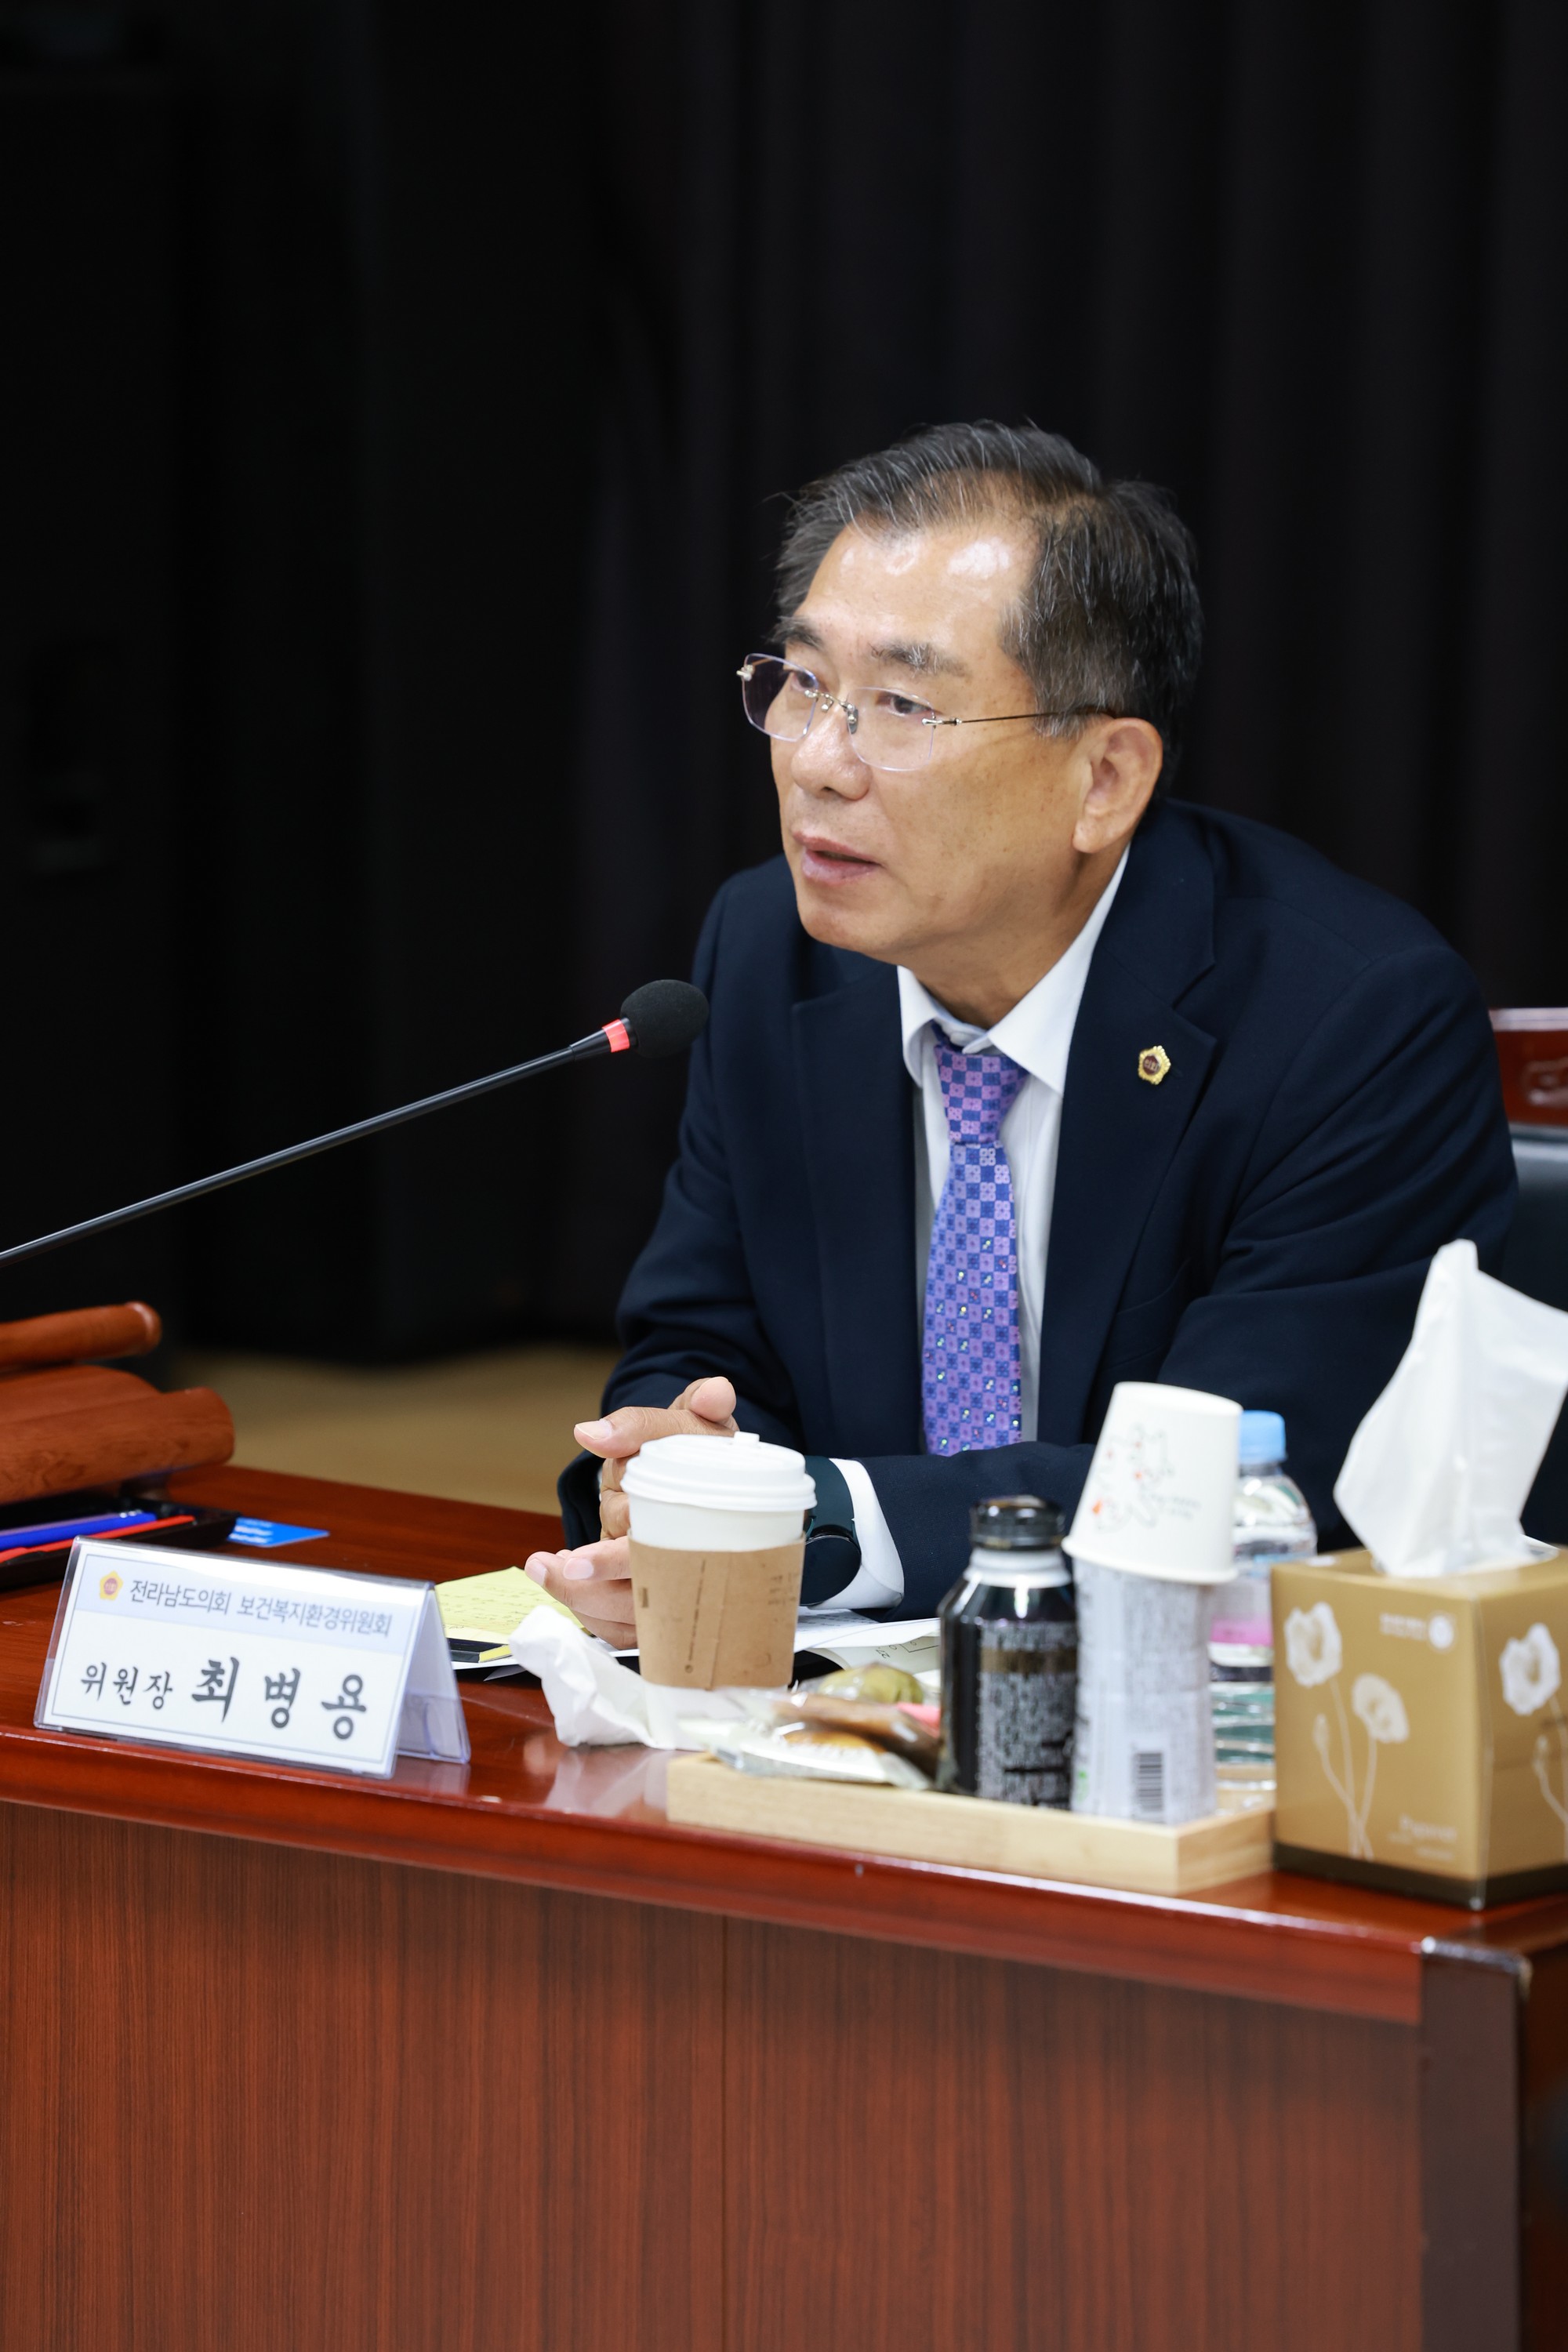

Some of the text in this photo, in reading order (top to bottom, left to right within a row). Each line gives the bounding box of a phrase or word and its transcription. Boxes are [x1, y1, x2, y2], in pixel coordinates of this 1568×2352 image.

[130, 1580, 392, 1637] 전라남도의회 보건복지환경위원회
[81, 1662, 172, 1710] 위원장
